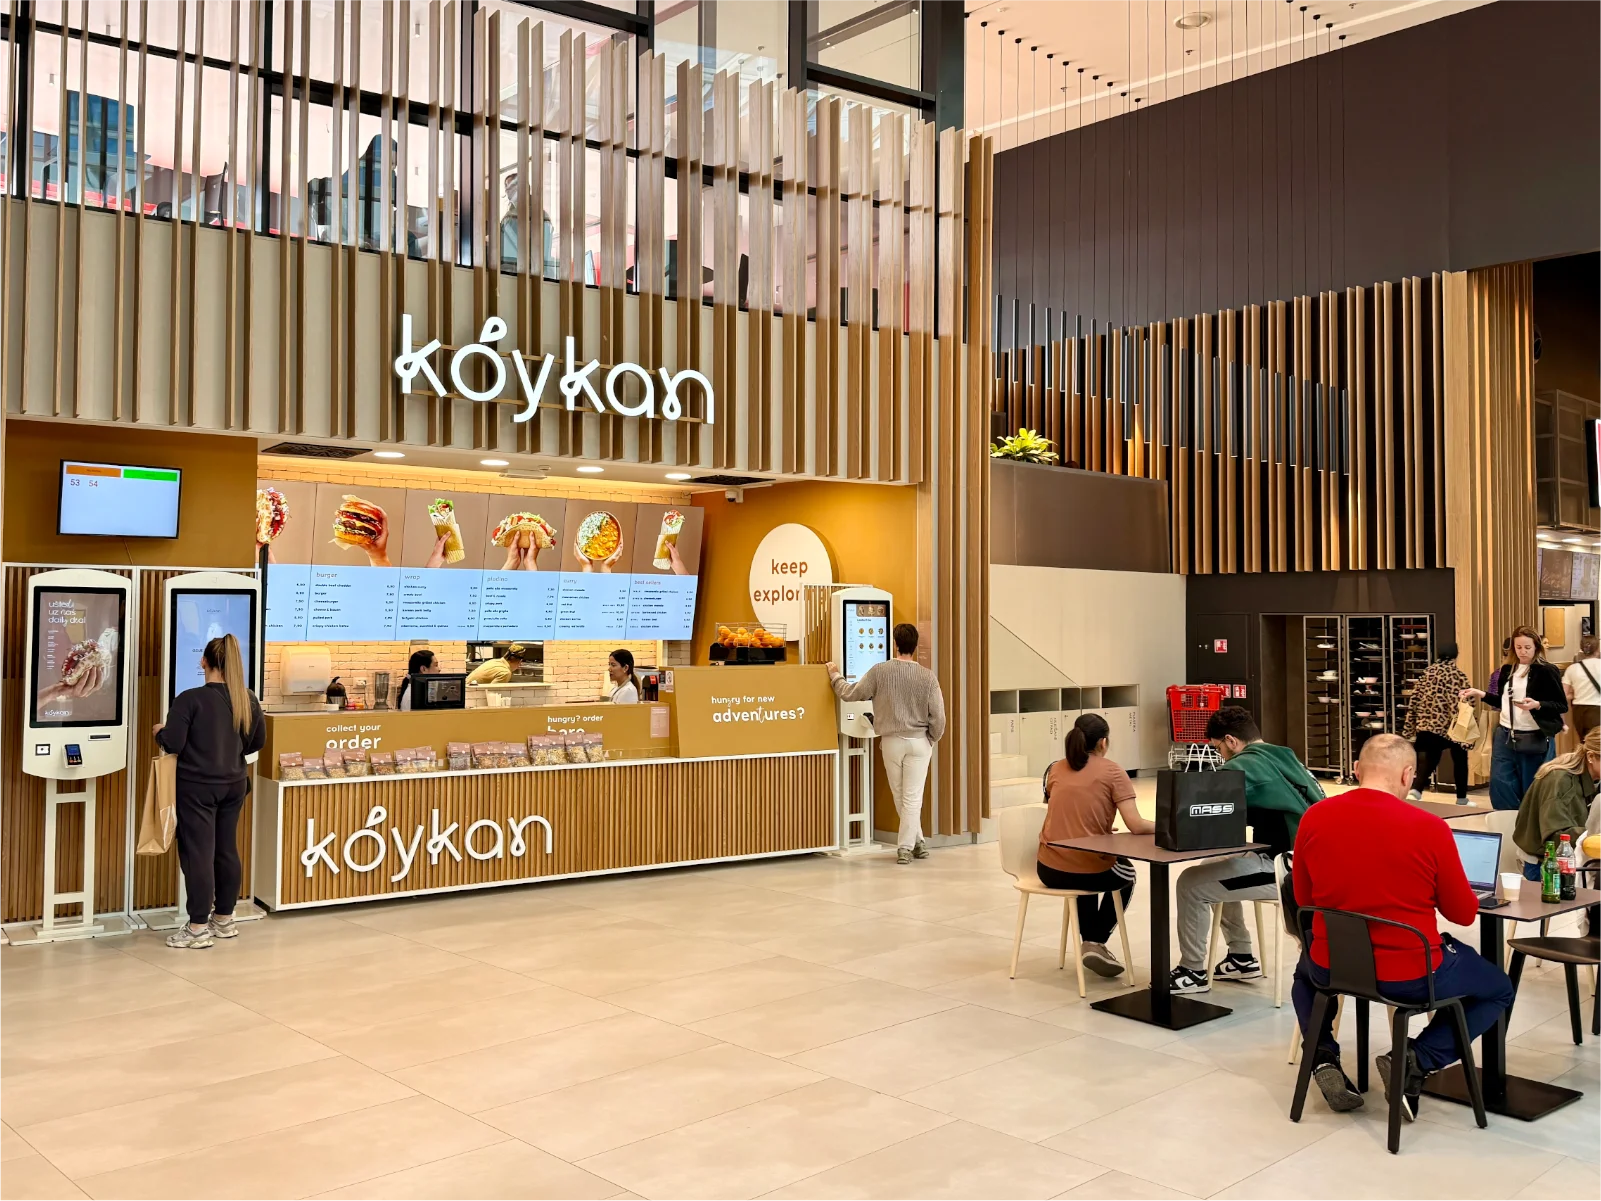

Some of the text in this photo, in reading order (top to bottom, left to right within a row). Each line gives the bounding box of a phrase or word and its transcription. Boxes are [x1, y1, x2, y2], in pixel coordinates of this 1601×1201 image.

[70, 478, 98, 487] 53 54
[771, 558, 808, 578] keep
[753, 585, 826, 605] explor
[48, 616, 86, 627] daily deal
[711, 696, 741, 708] hungry
[742, 695, 755, 703] for
[547, 714, 604, 724] hungry? order
[712, 705, 805, 724] adventures?
[326, 724, 382, 733] collect your
[326, 734, 382, 750] order
[1191, 805, 1232, 814] MASS
